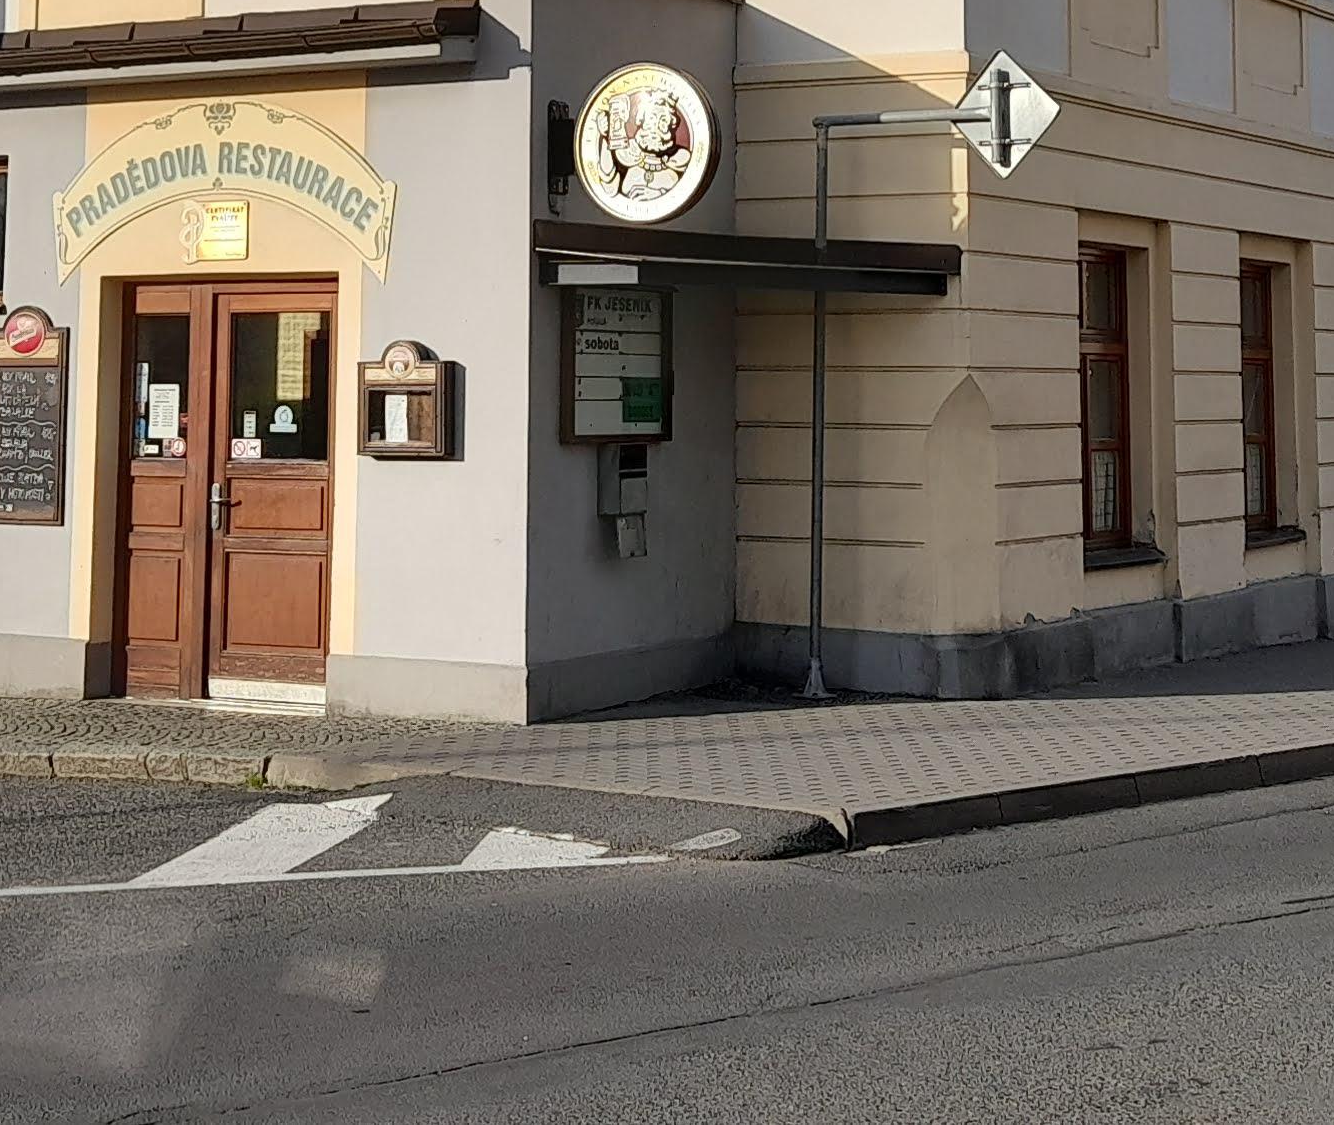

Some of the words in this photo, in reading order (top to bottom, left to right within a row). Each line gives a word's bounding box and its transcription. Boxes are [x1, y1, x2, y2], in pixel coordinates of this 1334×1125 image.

[65, 143, 208, 238] PRADĚDOVA
[218, 141, 380, 233] RESTAURACE
[584, 336, 619, 351] sobota
